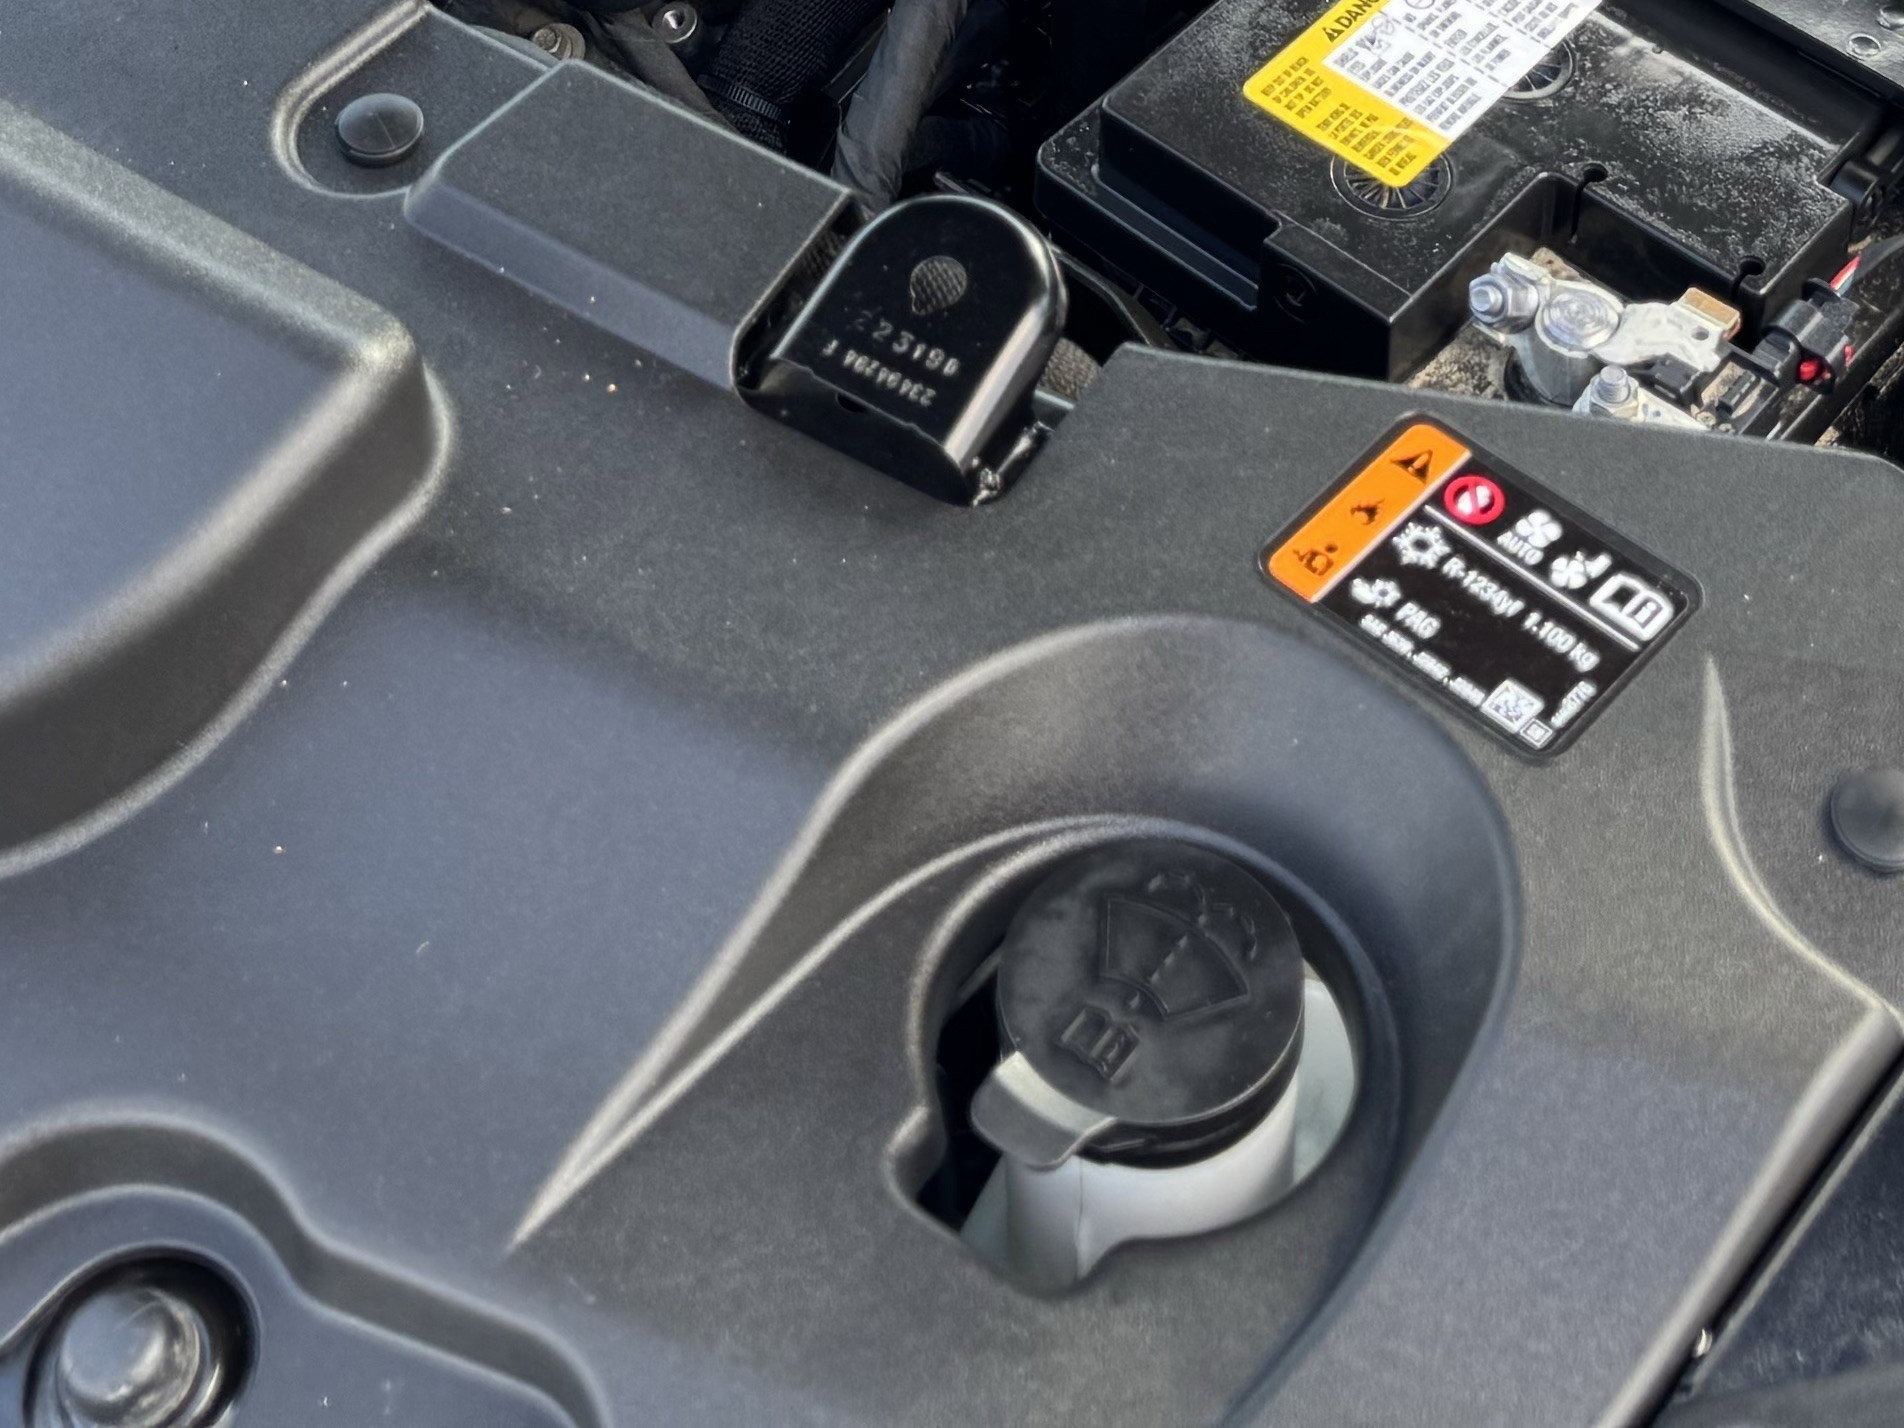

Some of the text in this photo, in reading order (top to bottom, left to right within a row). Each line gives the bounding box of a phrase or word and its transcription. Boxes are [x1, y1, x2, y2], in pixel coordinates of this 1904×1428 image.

[1496, 529, 1544, 566] AUTO
[1395, 600, 1442, 640] PAG
[1442, 556, 1601, 674] R-1234yf 1.100 kg
